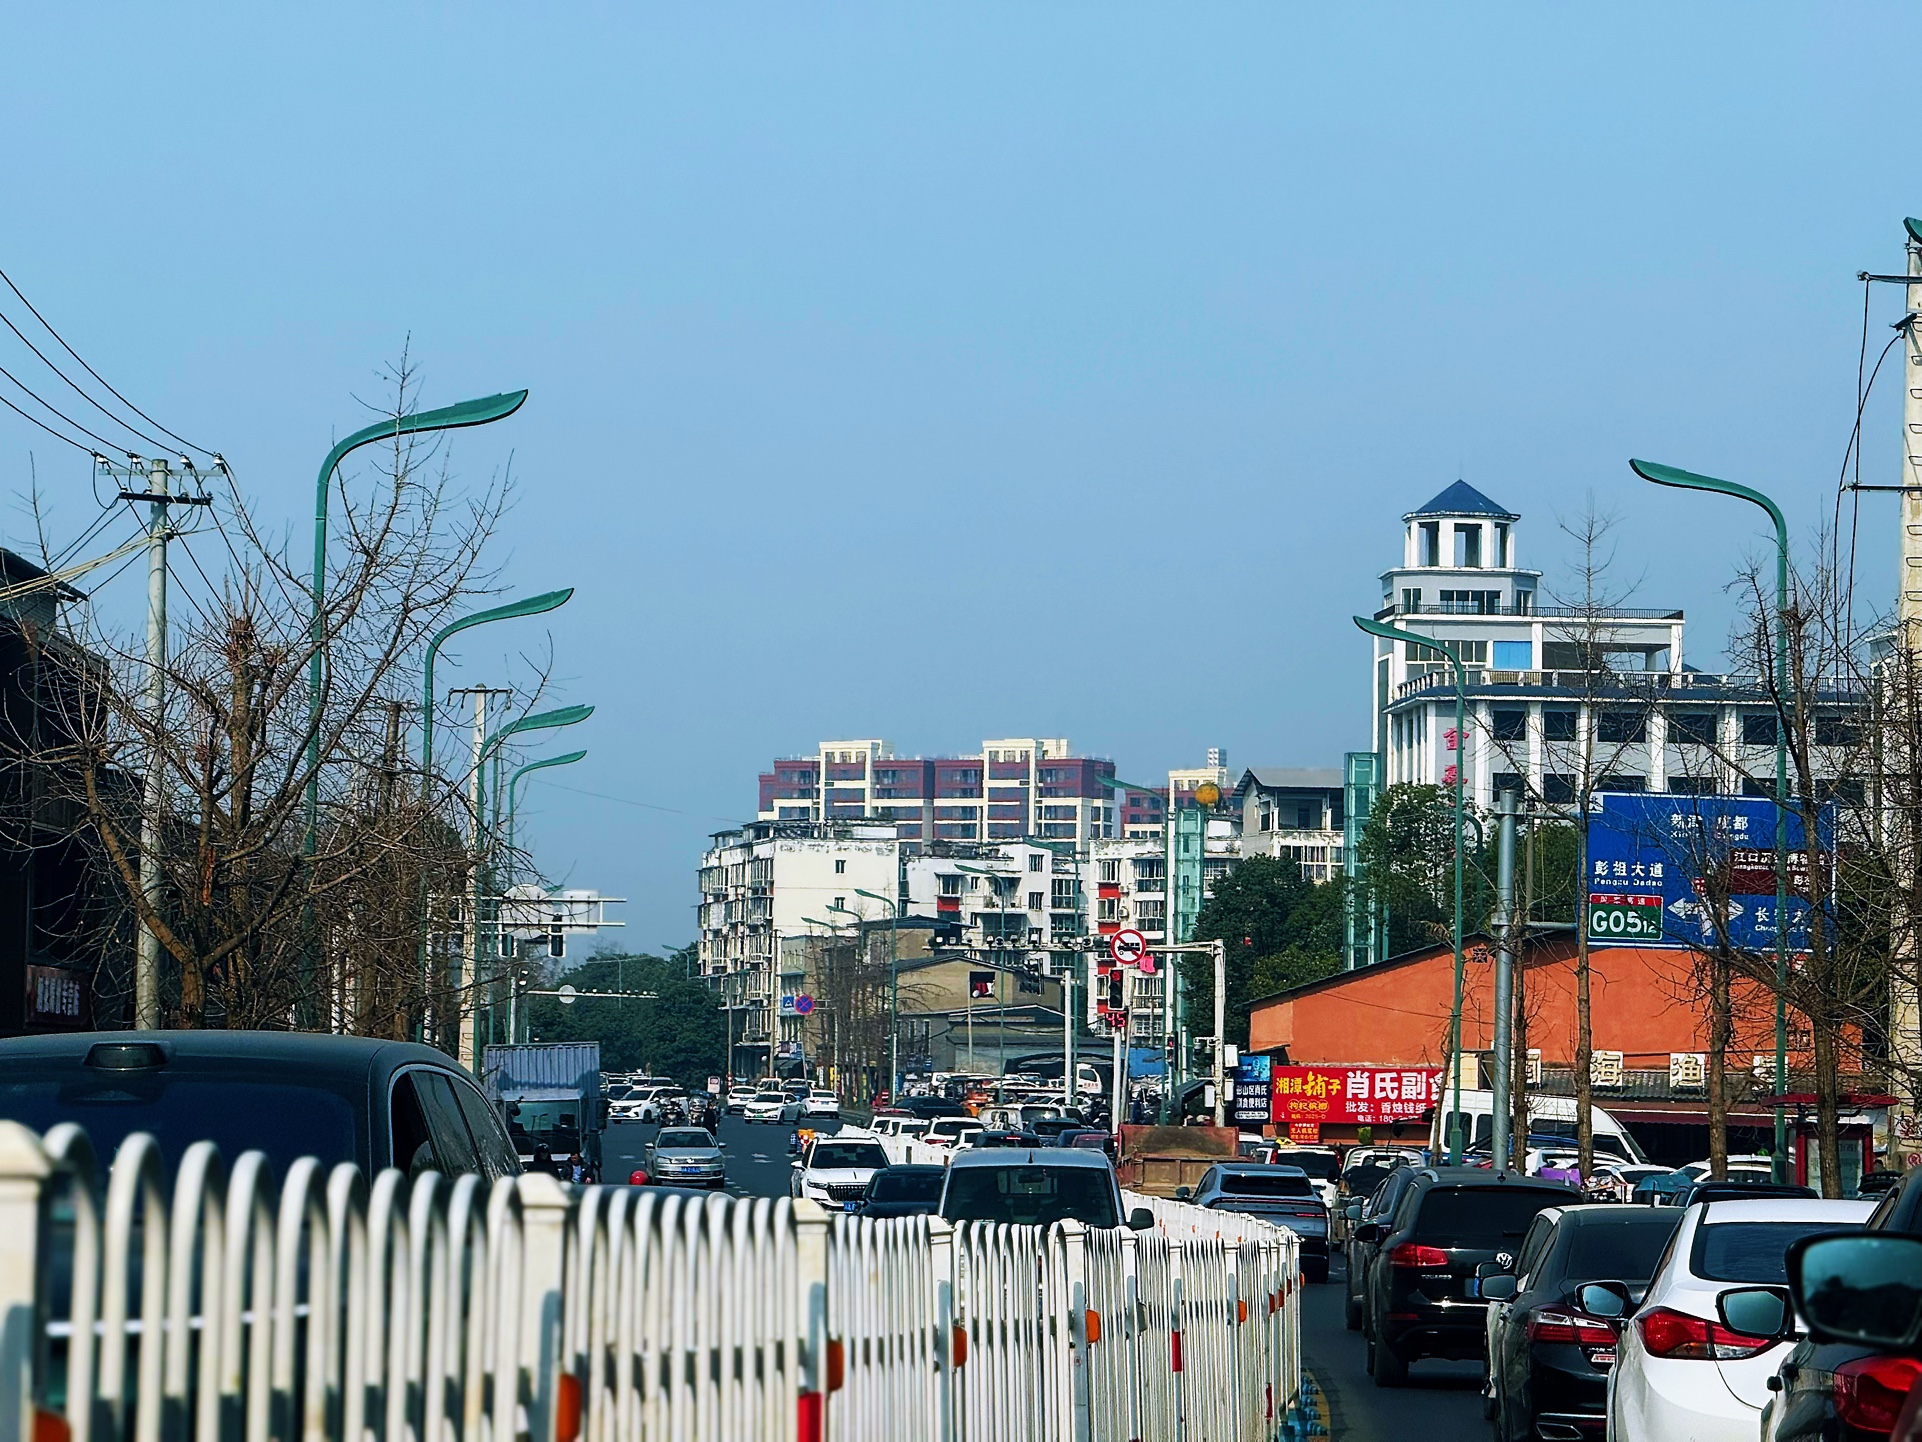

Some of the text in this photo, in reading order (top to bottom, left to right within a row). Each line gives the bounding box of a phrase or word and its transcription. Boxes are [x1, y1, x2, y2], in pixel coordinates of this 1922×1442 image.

[1594, 860, 1664, 878] 彭祖大道
[1106, 1011, 1126, 1028] 45
[1275, 1070, 1341, 1099] 湘潭铺子
